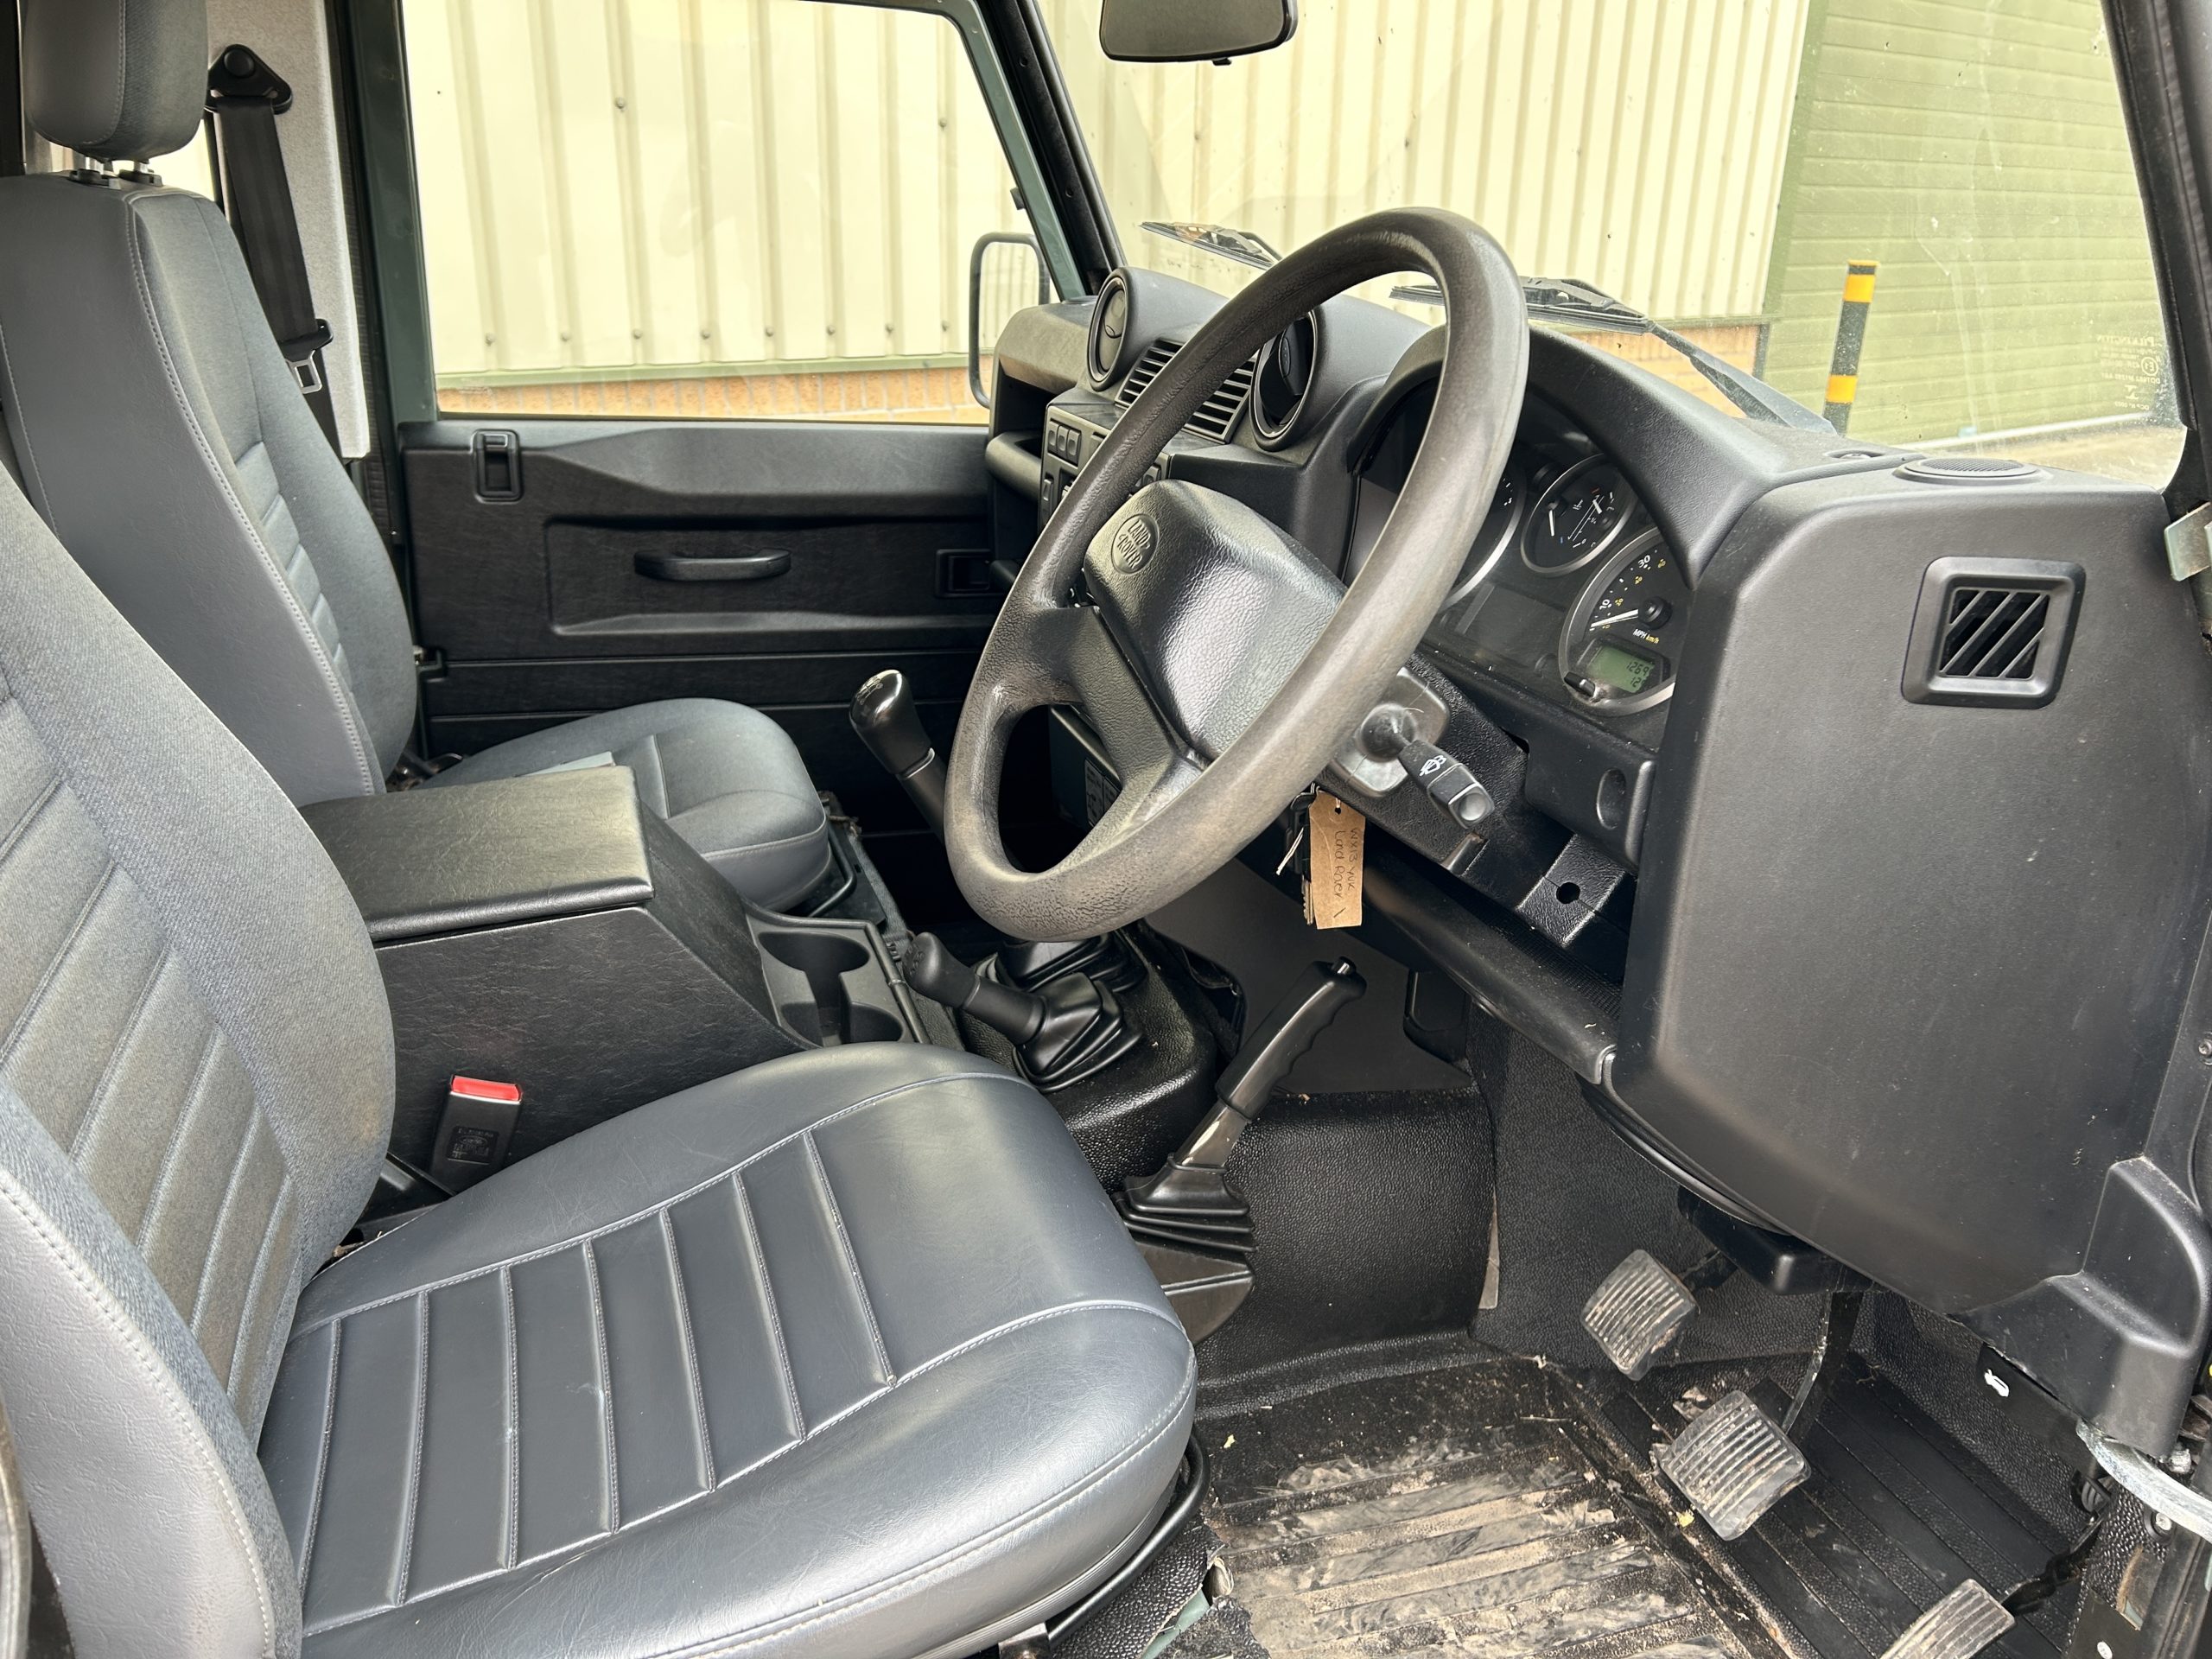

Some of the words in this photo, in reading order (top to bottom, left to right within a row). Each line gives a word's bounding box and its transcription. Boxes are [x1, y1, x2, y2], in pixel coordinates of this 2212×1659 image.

[1128, 518, 1151, 547] LAND
[1116, 537, 1143, 569] ROVER
[1637, 555, 1651, 569] 30
[1599, 599, 1611, 610] 10
[1632, 628, 1646, 639] MPH
[1334, 830, 1346, 860] Land
